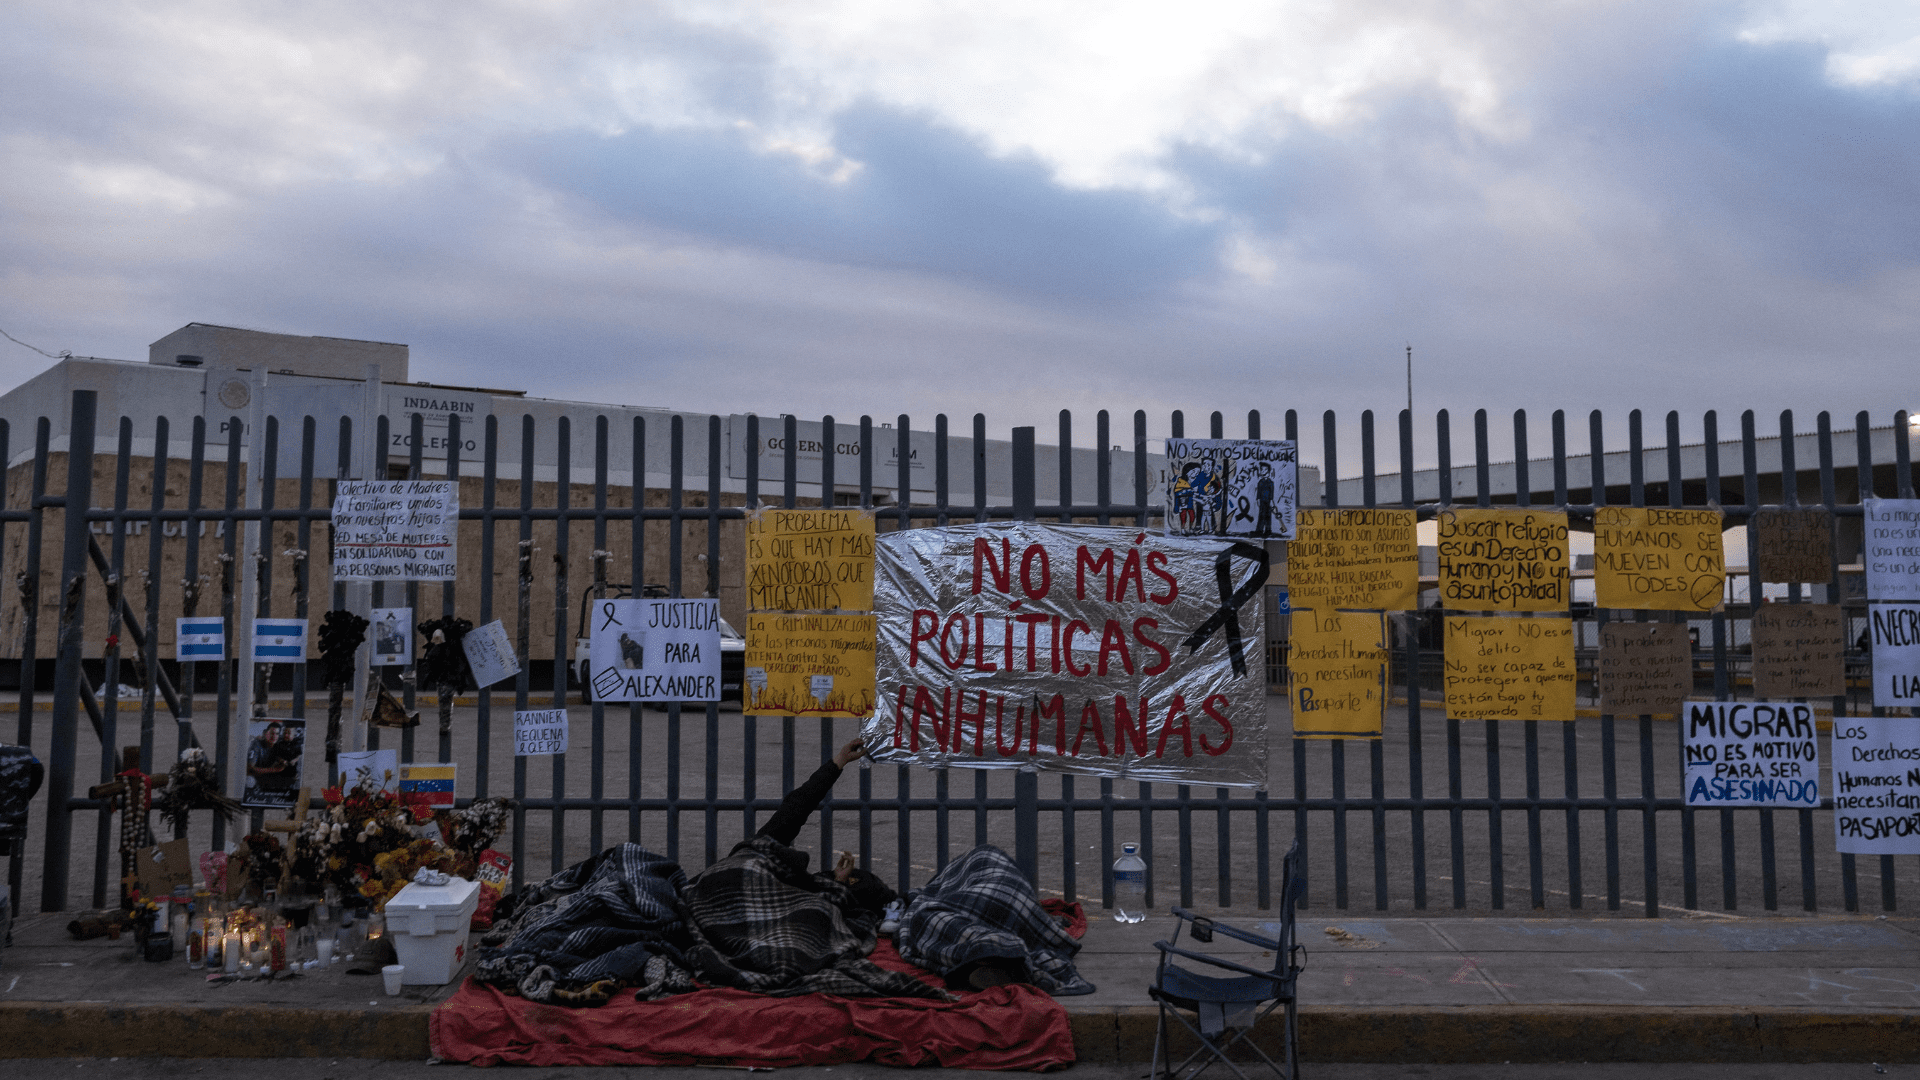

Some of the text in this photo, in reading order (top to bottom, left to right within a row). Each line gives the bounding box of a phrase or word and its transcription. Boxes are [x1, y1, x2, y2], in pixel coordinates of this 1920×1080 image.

[403, 397, 475, 412] INDAABIN
[1167, 441, 1188, 459] NO
[337, 481, 449, 496] Colectivo de Madres
[338, 499, 344, 512] y
[335, 514, 352, 527] por
[355, 512, 404, 526] nuestras
[775, 512, 851, 532] PROBLEMA
[1295, 509, 1412, 527] as migraciones
[1594, 508, 1718, 527] LOS DERECHOS
[355, 532, 383, 543] MESA
[386, 532, 398, 542] DE
[402, 533, 449, 544] MUJERES
[1341, 528, 1353, 541] no
[1356, 528, 1372, 541] son
[1439, 511, 1568, 547] Buscar refugio
[1873, 528, 1904, 539] no es
[750, 539, 763, 559] ES
[771, 537, 795, 560] QUE
[805, 537, 834, 558] HAY
[1440, 538, 1562, 561] es un Derecho
[1594, 529, 1718, 551] HUMANOS SE
[350, 547, 416, 560] SOLIDARIDAD
[424, 549, 444, 561] CON
[1351, 544, 1369, 558] que
[1896, 546, 1920, 557] nece
[350, 563, 401, 577] PERSONAS
[404, 562, 456, 577] MIGRANTES
[972, 533, 1179, 606] NO MÁS
[1313, 557, 1323, 568] de
[1325, 560, 1335, 568] la
[1518, 562, 1546, 580] NO
[1550, 565, 1570, 580] un
[1595, 552, 1721, 573] MUEVEN CON
[1872, 561, 1920, 575] es un de
[837, 561, 865, 584] QUE
[1359, 569, 1394, 583] BUSCAR
[1289, 580, 1403, 598] REFUGIO ES UN DERECHO
[1616, 572, 1688, 594] TODES
[750, 583, 842, 611] MIGRANTES
[1326, 593, 1374, 606] HUMANO
[649, 602, 719, 632] JUSTICIA
[750, 616, 766, 632] La
[1449, 620, 1573, 645] Migrar NO es un
[1873, 609, 1920, 647] NECR
[748, 634, 761, 649] de
[765, 634, 783, 649] las
[785, 637, 827, 650] personas
[910, 600, 1171, 678] POLÍTICAS
[665, 643, 701, 664] PARA
[747, 651, 784, 663] ATENTA
[786, 652, 818, 663] contra
[1289, 639, 1389, 662] Derechos Humanos
[1477, 642, 1521, 657] delito
[764, 663, 805, 674] DERECHOS
[808, 663, 851, 678] HUMANOS
[1292, 664, 1373, 685] no necesitan
[1478, 663, 1497, 674] ser
[1503, 662, 1547, 675] capaz
[1552, 656, 1566, 669] de
[623, 675, 716, 699] ALEXANDER
[1536, 673, 1576, 686] quienes
[1892, 674, 1920, 698] LIA
[1299, 687, 1361, 713] Pasaporte
[1447, 692, 1493, 705] están
[1497, 692, 1526, 704] bajo
[893, 684, 1233, 758] INHUMANAS
[1453, 705, 1519, 720] resguardo
[1689, 704, 1814, 740] MIGRAR
[516, 728, 564, 742] REQUENA
[1834, 722, 1868, 741] Los
[1686, 740, 1816, 762] NO ES MOTIVO
[1852, 742, 1920, 763] Derechos
[1715, 761, 1802, 779] PARA SER
[1689, 775, 1818, 805] ASESINADO
[1838, 770, 1903, 794] Humanos
[1836, 788, 1920, 809] necesitan
